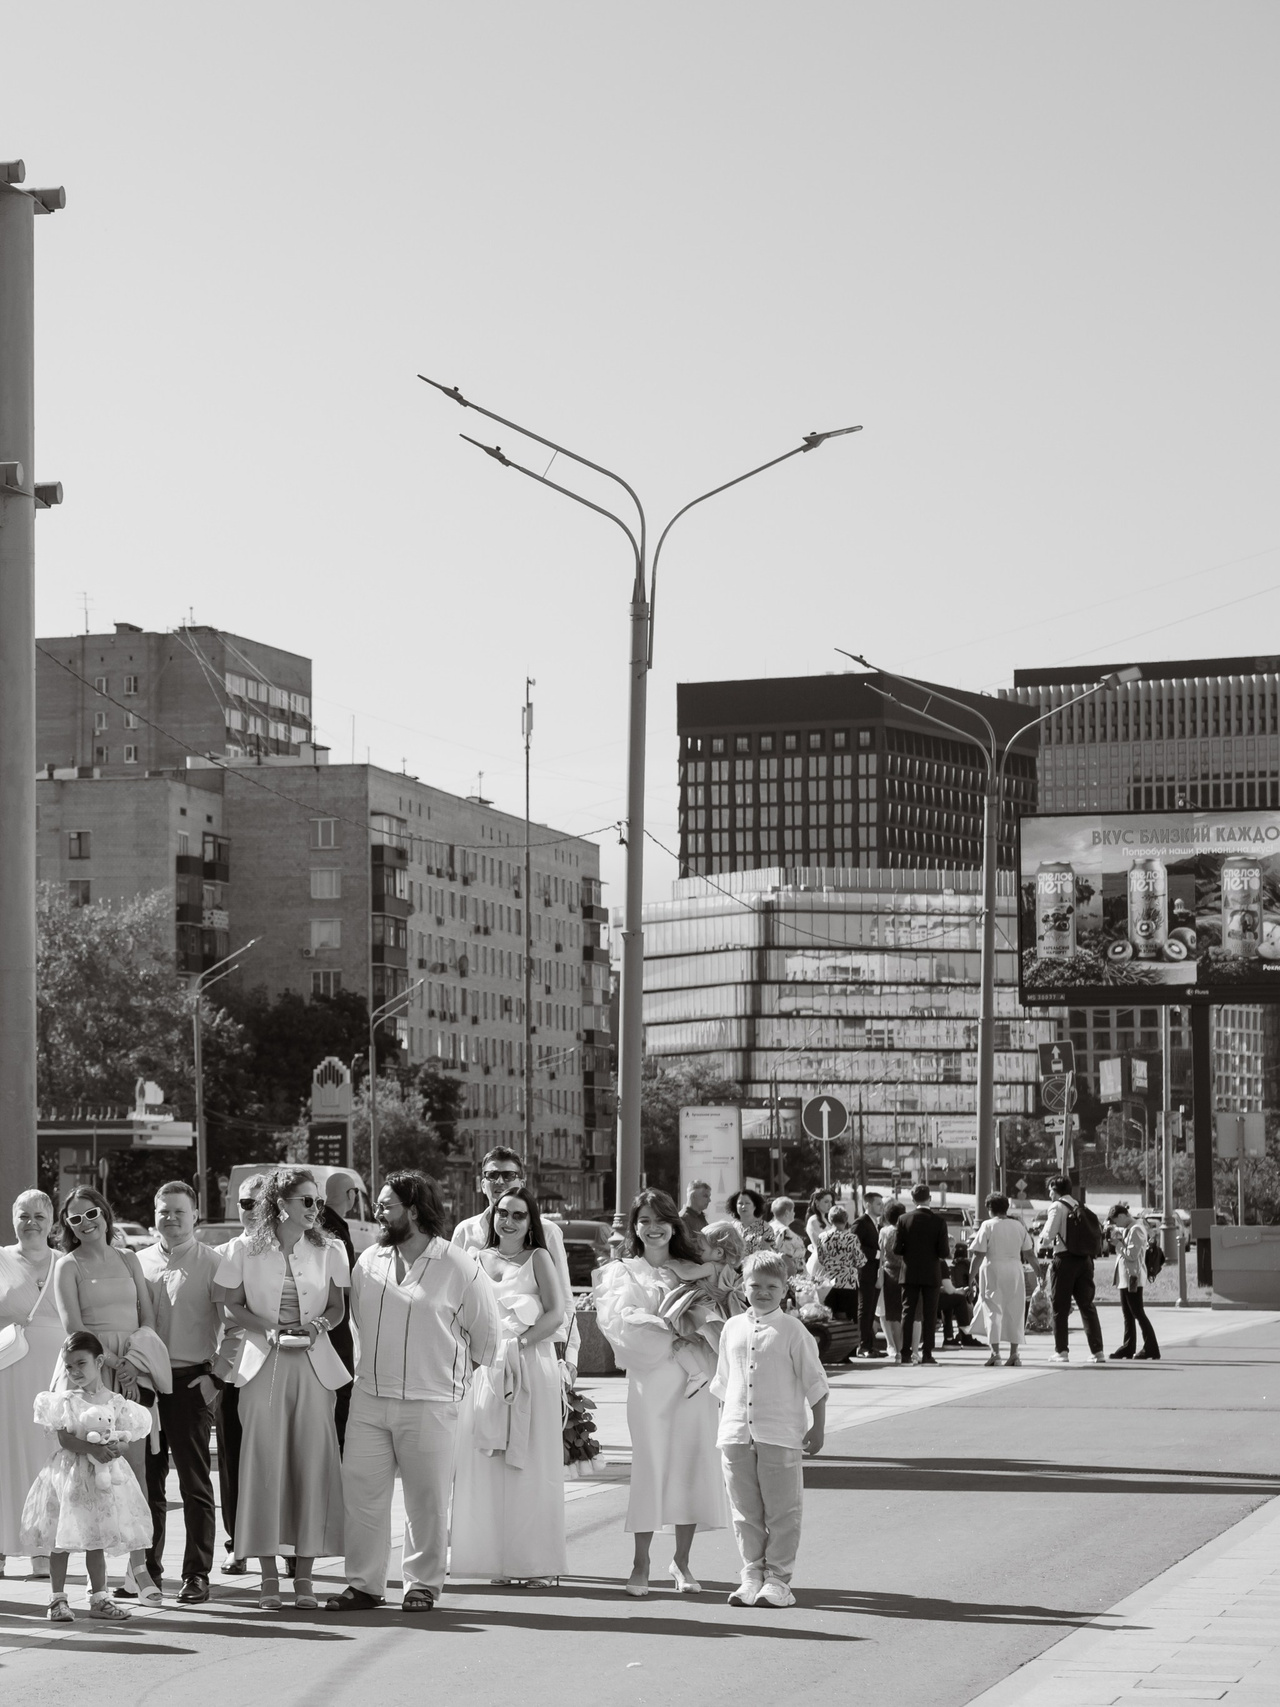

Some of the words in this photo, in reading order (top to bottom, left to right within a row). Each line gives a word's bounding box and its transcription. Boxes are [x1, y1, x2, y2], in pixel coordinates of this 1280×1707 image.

[1092, 830, 1134, 846] ВКУС
[1140, 825, 1211, 844] БЛИЗКИЙ
[1122, 847, 1167, 857] Попробуй
[1169, 847, 1194, 855] наши
